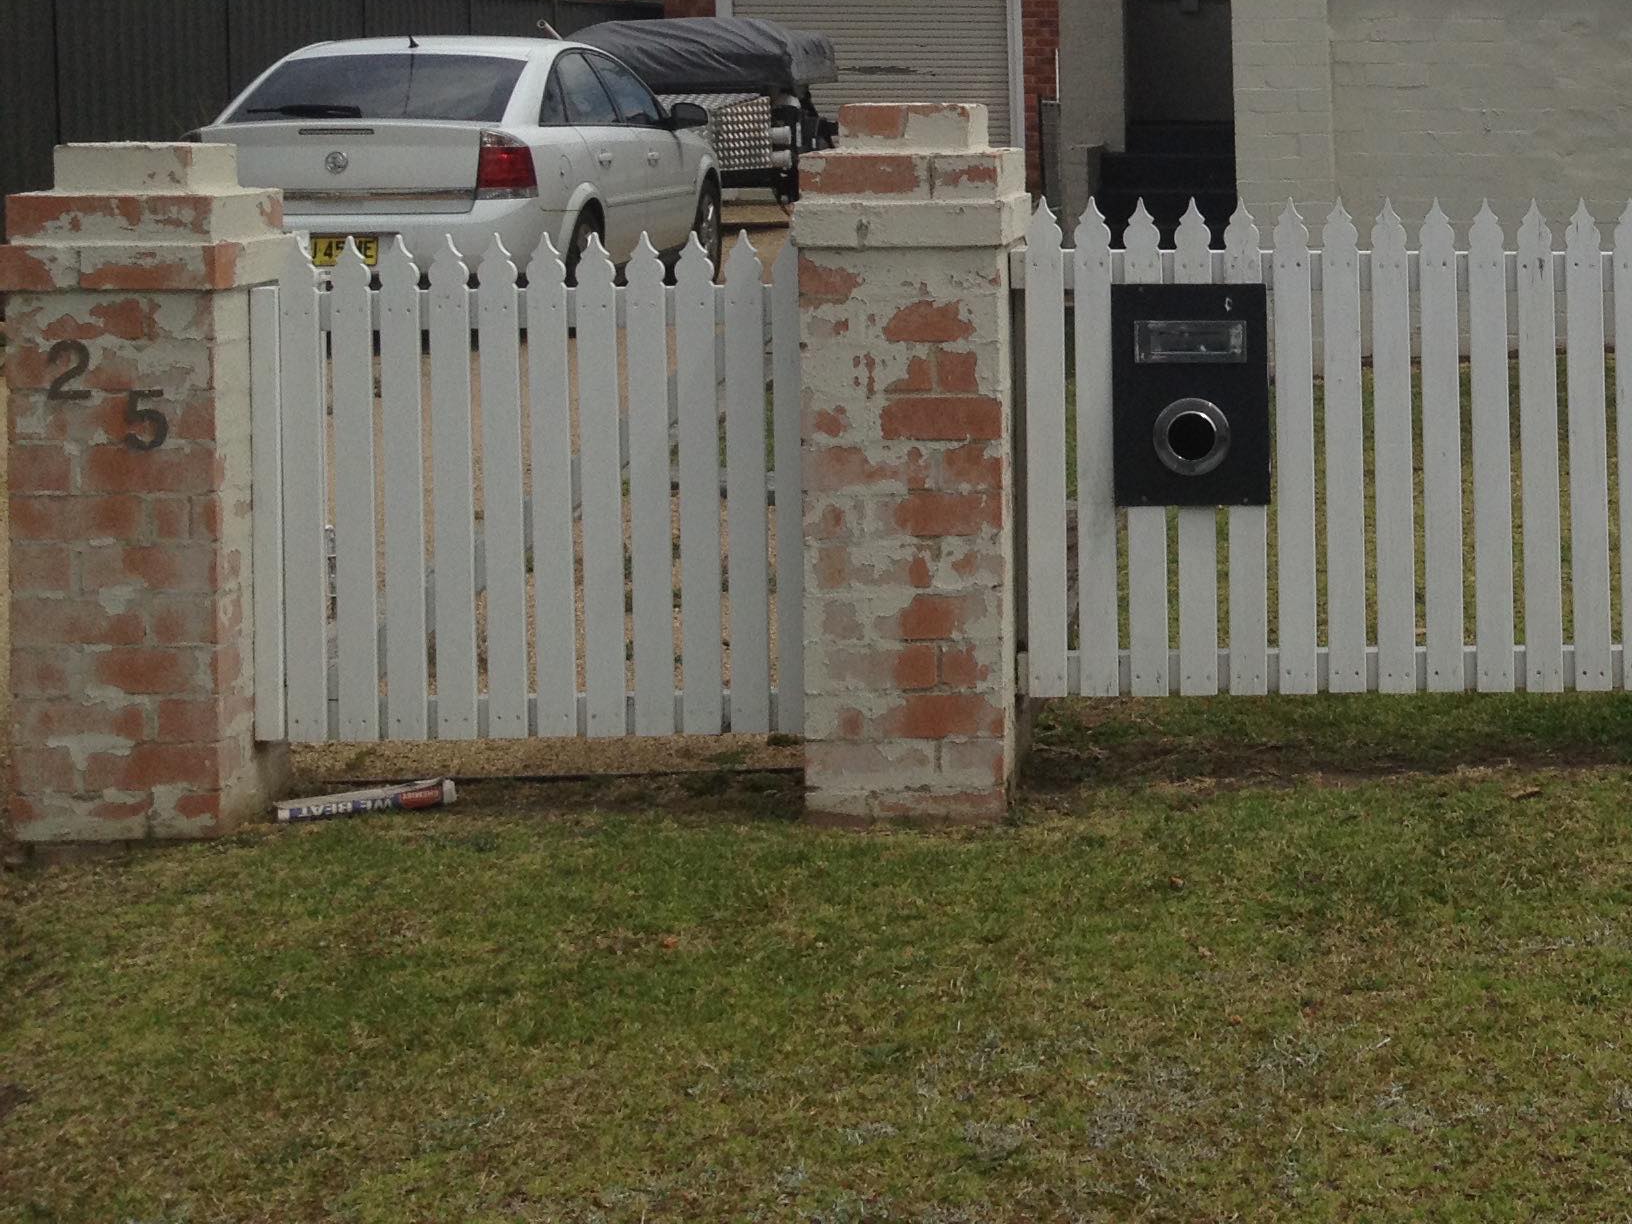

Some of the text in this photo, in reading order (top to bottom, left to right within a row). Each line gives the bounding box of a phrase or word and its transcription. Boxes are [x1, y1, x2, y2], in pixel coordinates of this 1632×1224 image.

[47, 340, 170, 451] 25
[299, 797, 392, 816] WE BEAT
